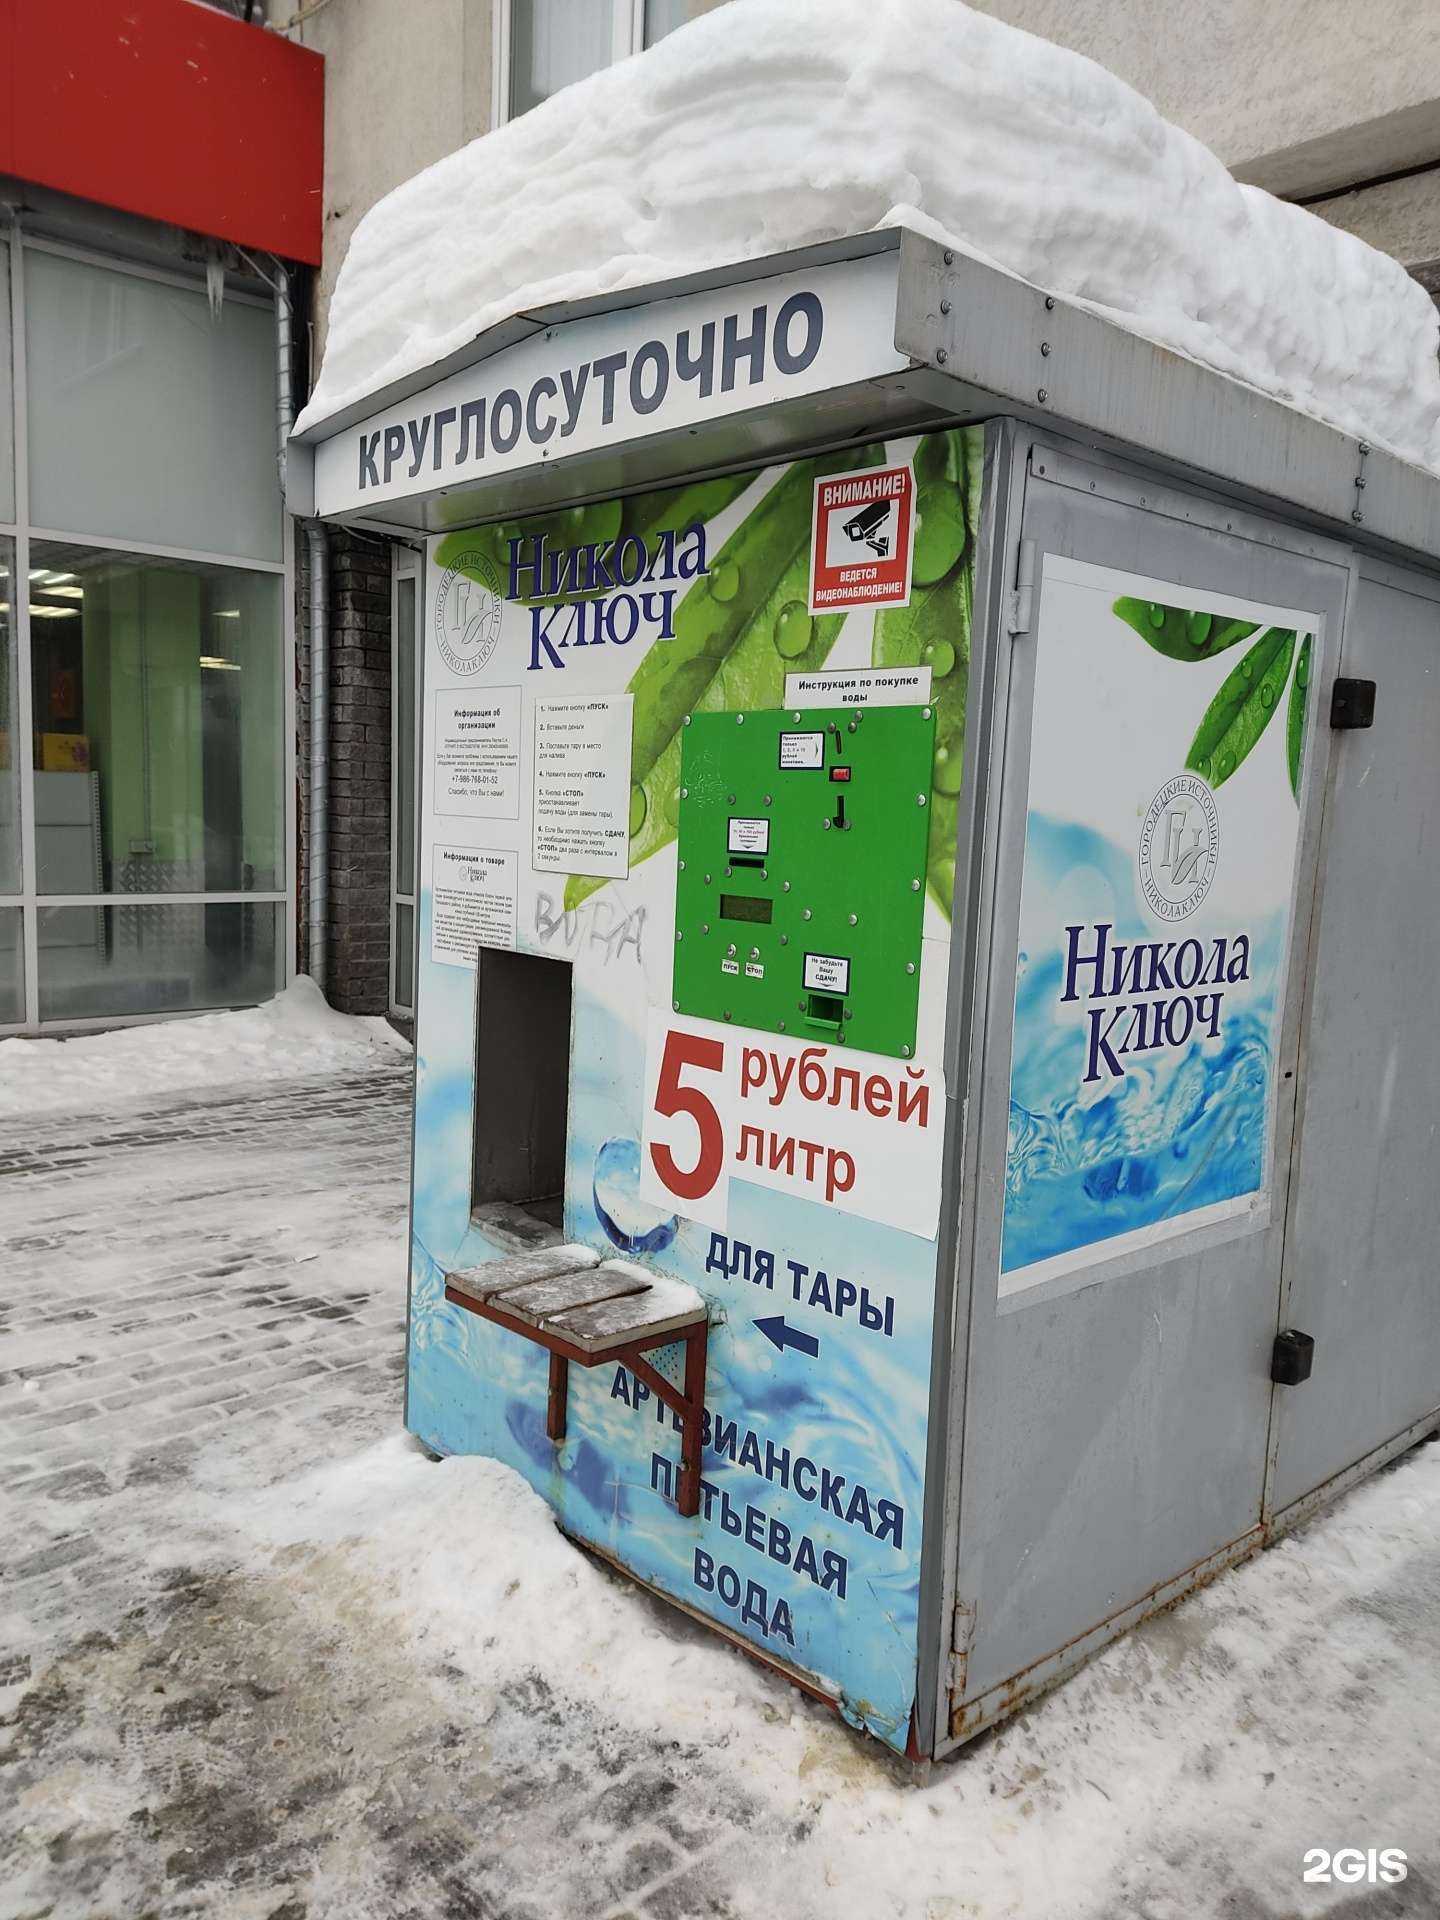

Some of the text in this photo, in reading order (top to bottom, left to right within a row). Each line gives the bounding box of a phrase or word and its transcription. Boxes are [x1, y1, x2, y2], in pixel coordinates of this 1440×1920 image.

[358, 292, 823, 490] КРУГЛОСУТОЧНО
[823, 473, 906, 507] ВНИМАНИЕ!
[816, 581, 903, 602] ВИДЕОНАБЛЮДЕНИЕ!
[840, 567, 878, 583] ВЕДЕТСЯ
[454, 709, 491, 719] Информация
[798, 676, 919, 691] Инструкция по покупке
[842, 693, 868, 702] воды
[1060, 924, 1250, 1002] Никола
[1083, 992, 1225, 1083] Ключ
[650, 1029, 930, 1200] 5 рублей
[735, 1124, 857, 1202] литр
[705, 1231, 895, 1337] ДЛЯ ТАРЫ
[651, 1452, 848, 1600] ПТЬЕВАЯ
[694, 1547, 796, 1647] ВОДА
